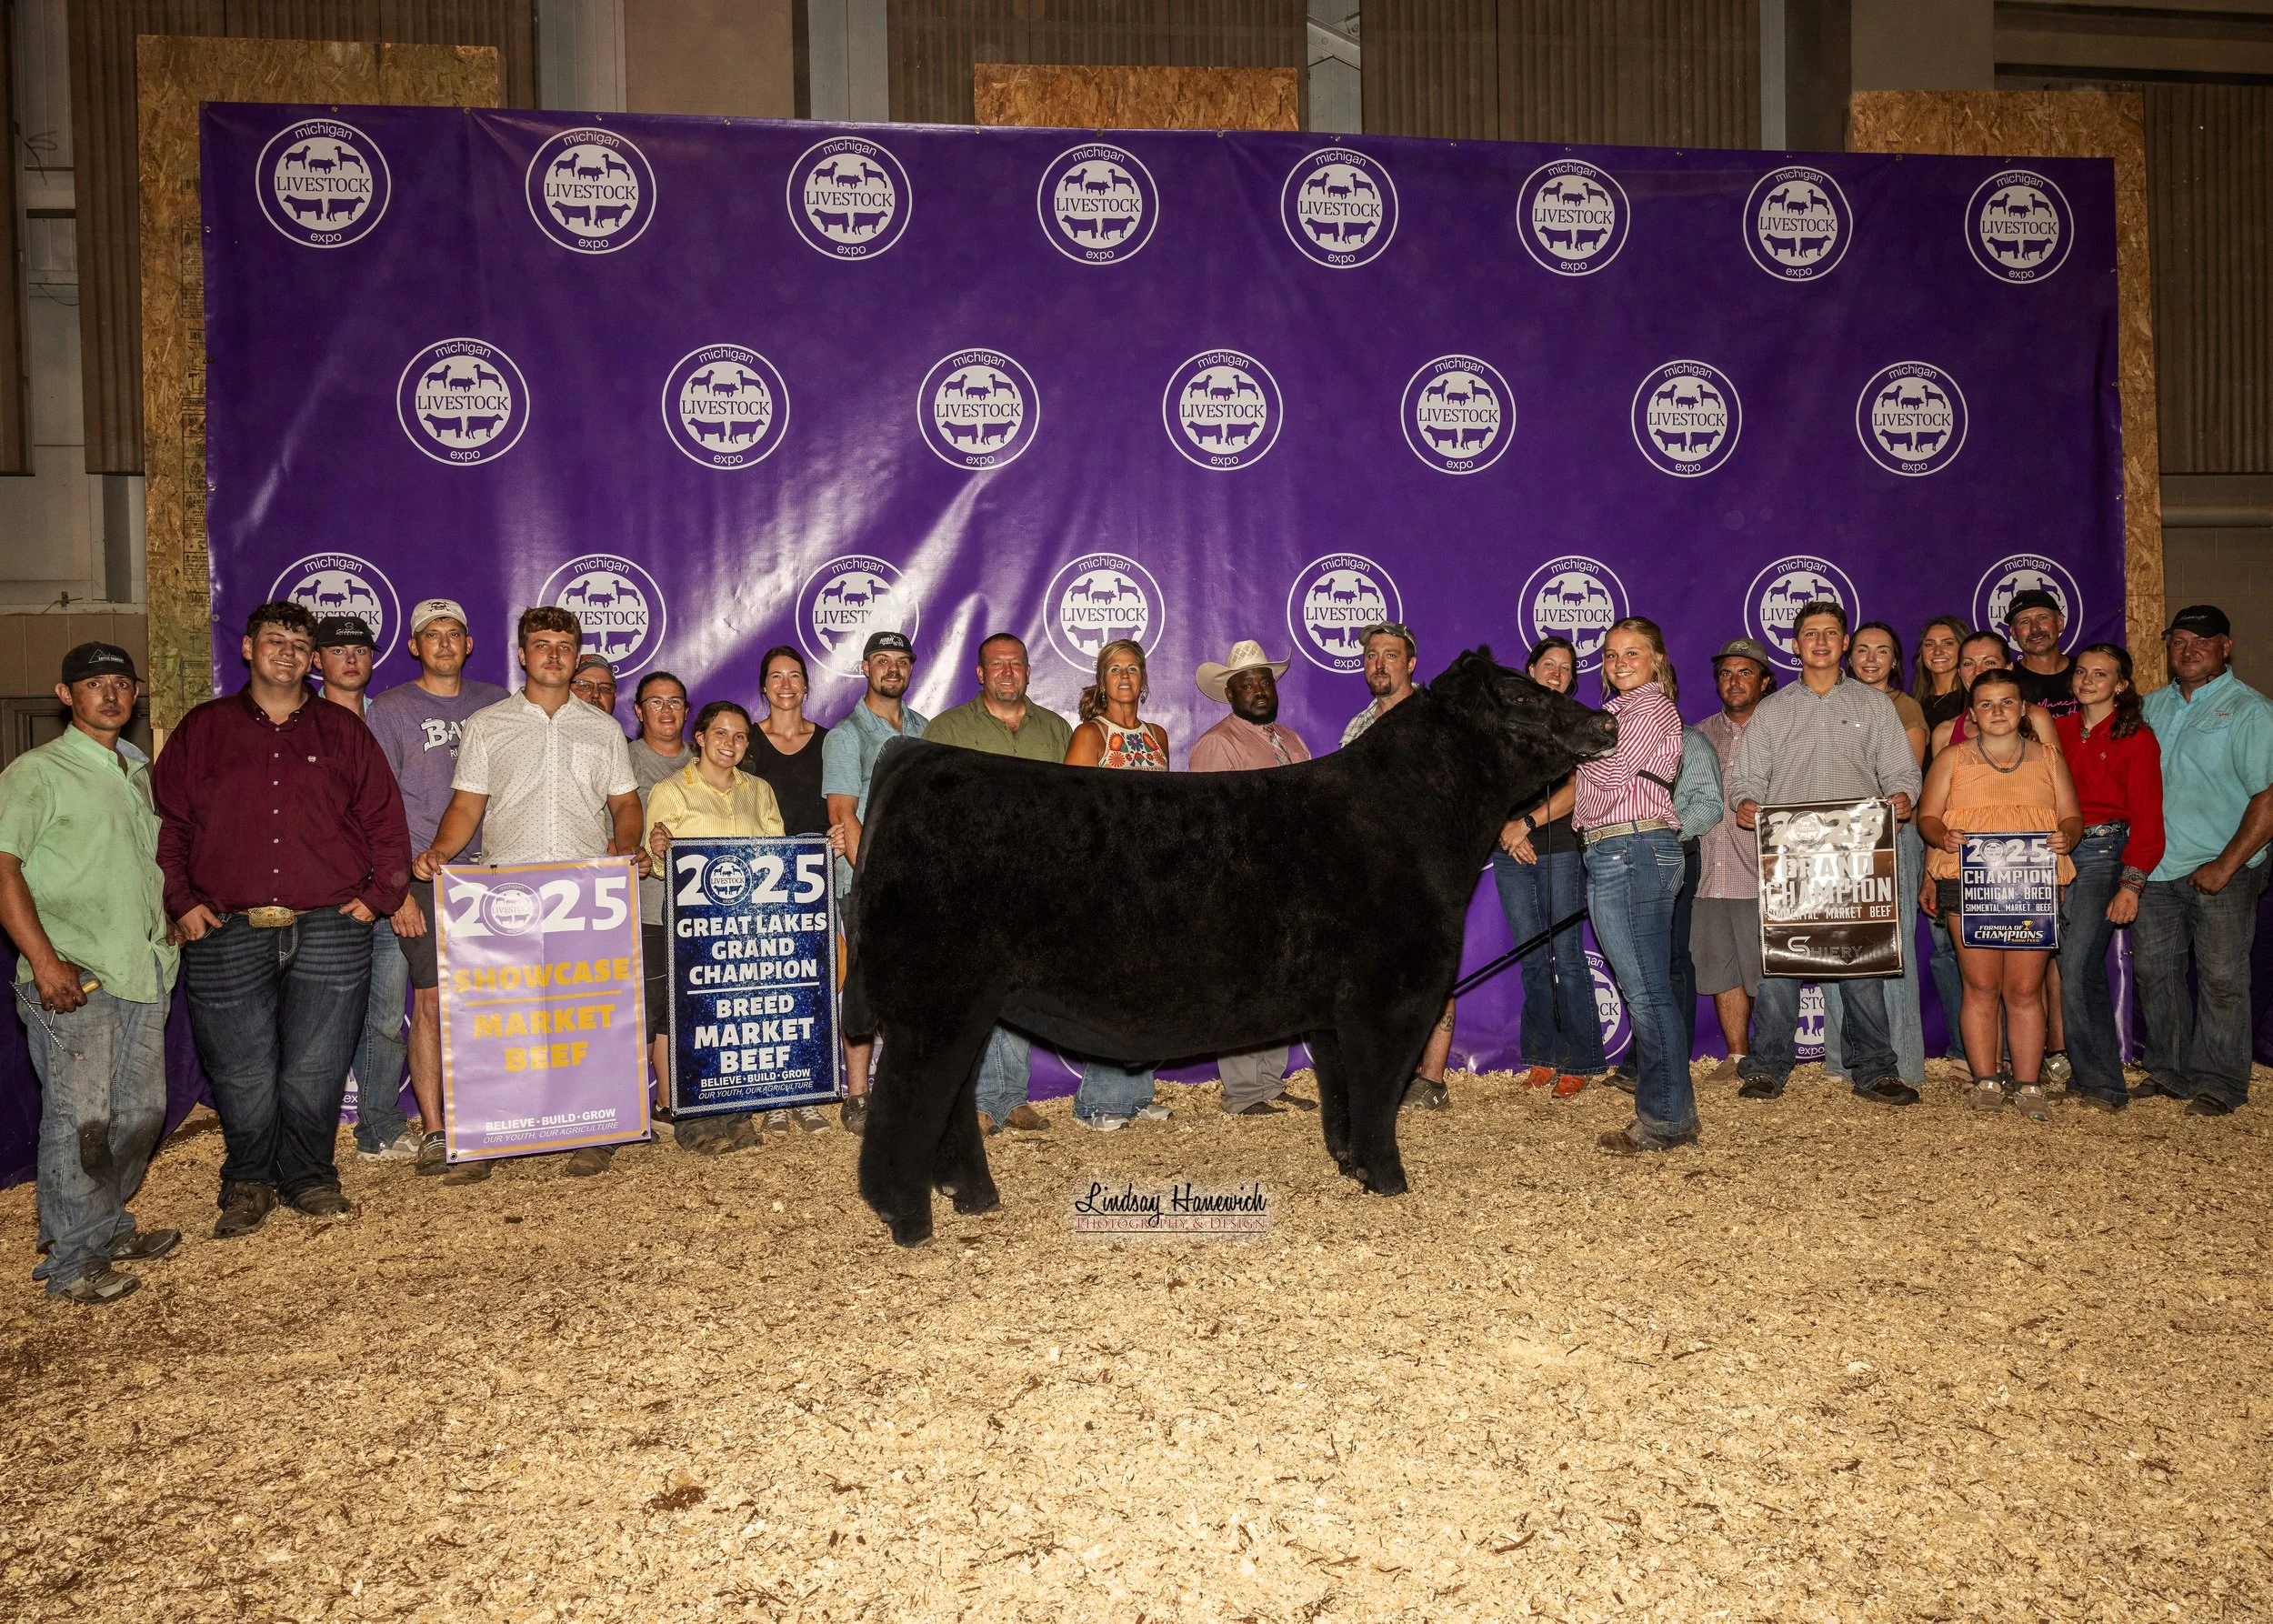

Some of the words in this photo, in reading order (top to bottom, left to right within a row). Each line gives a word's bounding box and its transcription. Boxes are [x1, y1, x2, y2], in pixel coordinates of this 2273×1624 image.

[295, 122, 353, 140] michigan
[563, 130, 620, 148] michigan
[823, 139, 877, 156] michigan
[1072, 146, 1125, 163] michigan
[1315, 150, 1367, 167] michigan
[1547, 162, 1597, 178] michigan
[1775, 168, 1824, 185] michigan
[276, 176, 370, 192] LIVESTOCK
[1996, 171, 2044, 188] michigan
[546, 183, 636, 199] LIVESTOCK
[806, 191, 893, 206] LIVESTOCK
[1056, 198, 1140, 212] LIVESTOCK
[1299, 201, 1380, 217] LIVESTOCK
[1535, 208, 1612, 224] LIVESTOCK
[1760, 217, 1836, 232] LIVESTOCK
[1982, 221, 2057, 235] LIVESTOCK
[310, 231, 343, 246] expo
[578, 238, 609, 251] expo
[837, 245, 866, 257] expo
[1086, 250, 1115, 262] expo
[1328, 254, 1356, 266] expo
[1561, 260, 1587, 273] expo
[1786, 266, 1811, 278] expo
[2009, 269, 2035, 281] expo
[435, 341, 491, 358] michigan
[698, 346, 754, 365] michigan
[952, 351, 1006, 368] michigan
[1197, 352, 1249, 369] michigan
[1435, 357, 1485, 375] michigan
[1664, 361, 1712, 379] michigan
[1888, 364, 1938, 379] michigan
[418, 396, 508, 410] LIVESTOCK
[682, 400, 770, 415] LIVESTOCK
[936, 404, 1021, 417] LIVESTOCK
[1182, 405, 1264, 417] LIVESTOCK
[1419, 408, 1497, 422] LIVESTOCK
[1649, 413, 1725, 426] LIVESTOCK
[1874, 414, 1950, 426] LIVESTOCK
[450, 450, 481, 463] expo
[714, 455, 744, 466] expo
[966, 455, 995, 467] expo
[1211, 456, 1239, 467] expo
[1447, 460, 1474, 472] expo
[1676, 463, 1701, 475] expo
[1902, 462, 1928, 474] expo
[304, 556, 363, 573] michigan
[574, 557, 630, 574] michigan
[831, 558, 885, 574] michigan
[1078, 556, 1131, 572] michigan
[1320, 556, 1371, 573] michigan
[1550, 558, 1599, 575] michigan
[1777, 556, 1827, 574] michigan
[2004, 555, 2052, 572] michigan
[576, 611, 646, 625] VESTOCK
[1062, 608, 1146, 621] LIVESTOCK
[1306, 607, 1385, 621] LIVESTOCK
[1536, 609, 1612, 622] LIVESTOCK
[1762, 608, 1801, 621] LIVES
[1334, 657, 1362, 671] expo
[1781, 856, 1874, 878] GRAND
[1964, 870, 2052, 885] CHAMPION
[1766, 877, 1892, 905] CHAMPION
[1965, 887, 2016, 900] MICHIGAN
[2025, 887, 2052, 900] BRED
[1826, 907, 1861, 919] MARKET
[1869, 905, 1891, 918] BEEF
[1965, 904, 2000, 912] SIMMENTAL
[2006, 904, 2031, 912] MARKET
[2036, 903, 2051, 912] BEEF
[676, 917, 756, 938] GREAT
[756, 913, 827, 933] LAKES
[1974, 930, 2045, 943] CHAMPIONS
[712, 938, 795, 960] GRAND
[454, 958, 631, 993] SHOWCASE
[689, 959, 817, 986] CHAMPION
[716, 995, 795, 1018] BREED
[474, 1004, 616, 1039] MARKET
[694, 1018, 815, 1049] MARKET
[505, 1043, 588, 1073] BEEF
[720, 1046, 790, 1073] BEEF
[1798, 1047, 1825, 1057] expo
[701, 1076, 742, 1088] BELIEVE
[747, 1072, 776, 1083] BUILD
[781, 1068, 811, 1079] GROW
[698, 1091, 715, 1099] OUR
[746, 1085, 761, 1094] OUR
[762, 1080, 813, 1094] AGRICULTURE
[344, 1094, 358, 1104] ex
[486, 1118, 535, 1131] BELIEVE
[542, 1115, 576, 1127] BUILD
[582, 1108, 616, 1120] GROW
[484, 1134, 501, 1144] OUR
[539, 1128, 557, 1138] OUR
[558, 1122, 618, 1136] AGRICULTURE
